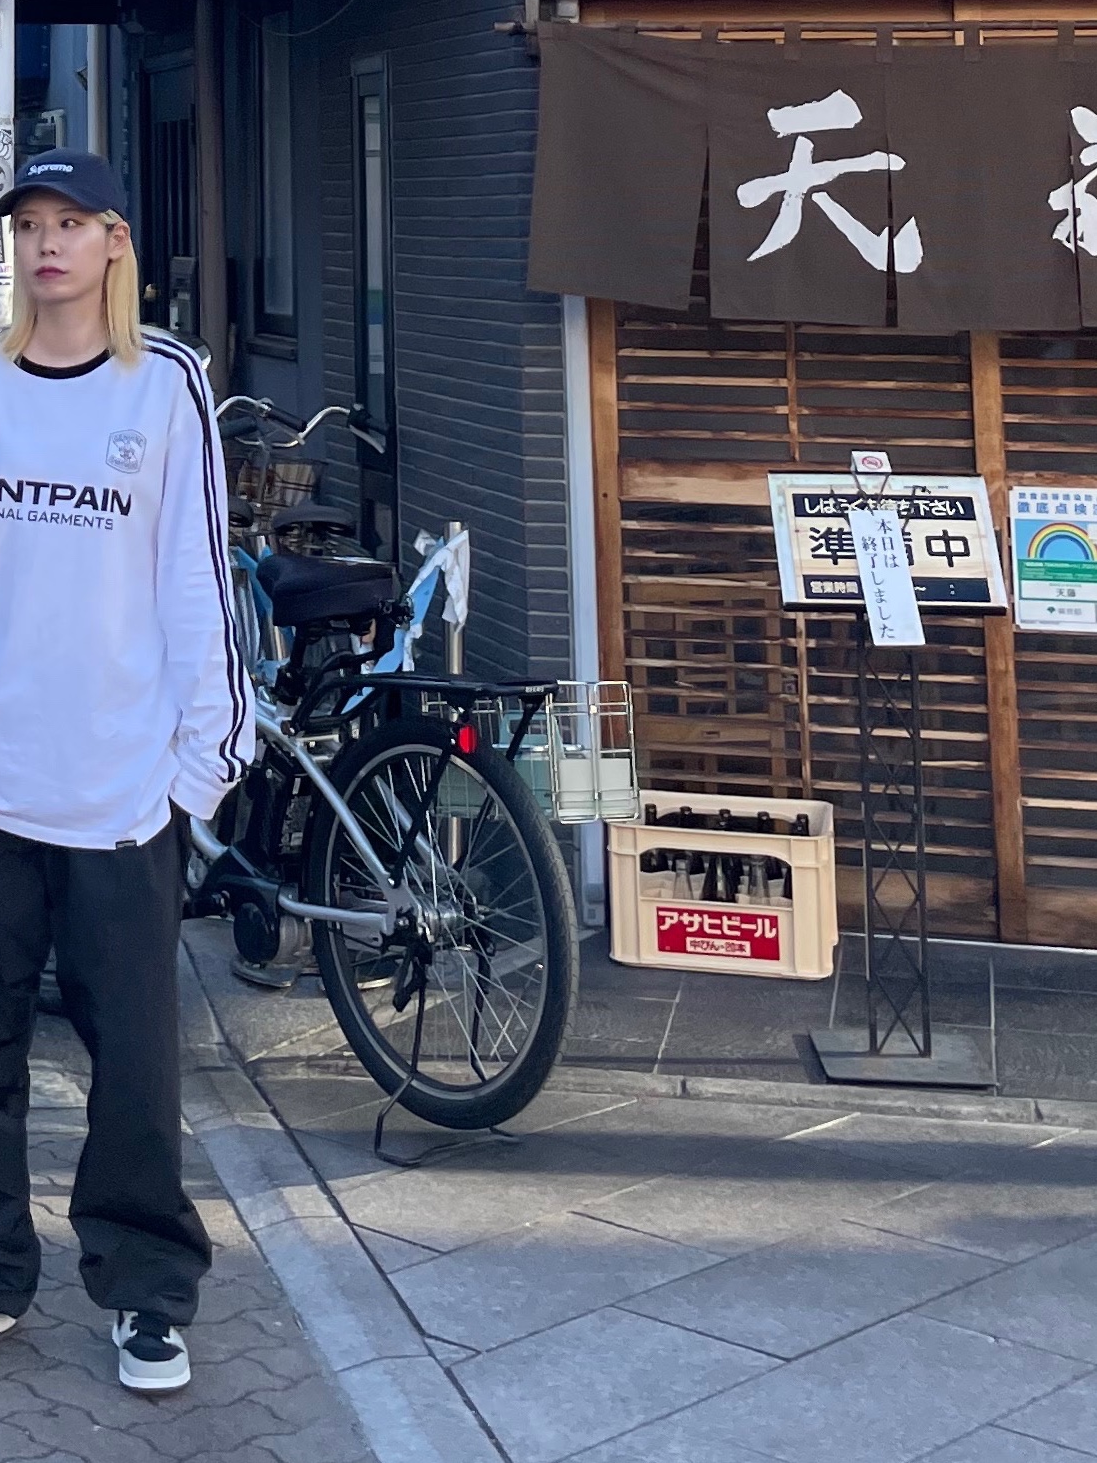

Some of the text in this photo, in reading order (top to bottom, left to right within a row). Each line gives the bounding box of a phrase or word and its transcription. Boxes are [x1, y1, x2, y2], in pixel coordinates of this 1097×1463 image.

[27, 510, 114, 531] GARMENTS
[809, 526, 971, 568] 準中
[876, 518, 900, 569] 本日は
[860, 536, 896, 639] 終了しました
[657, 910, 777, 939] アサヒビール
